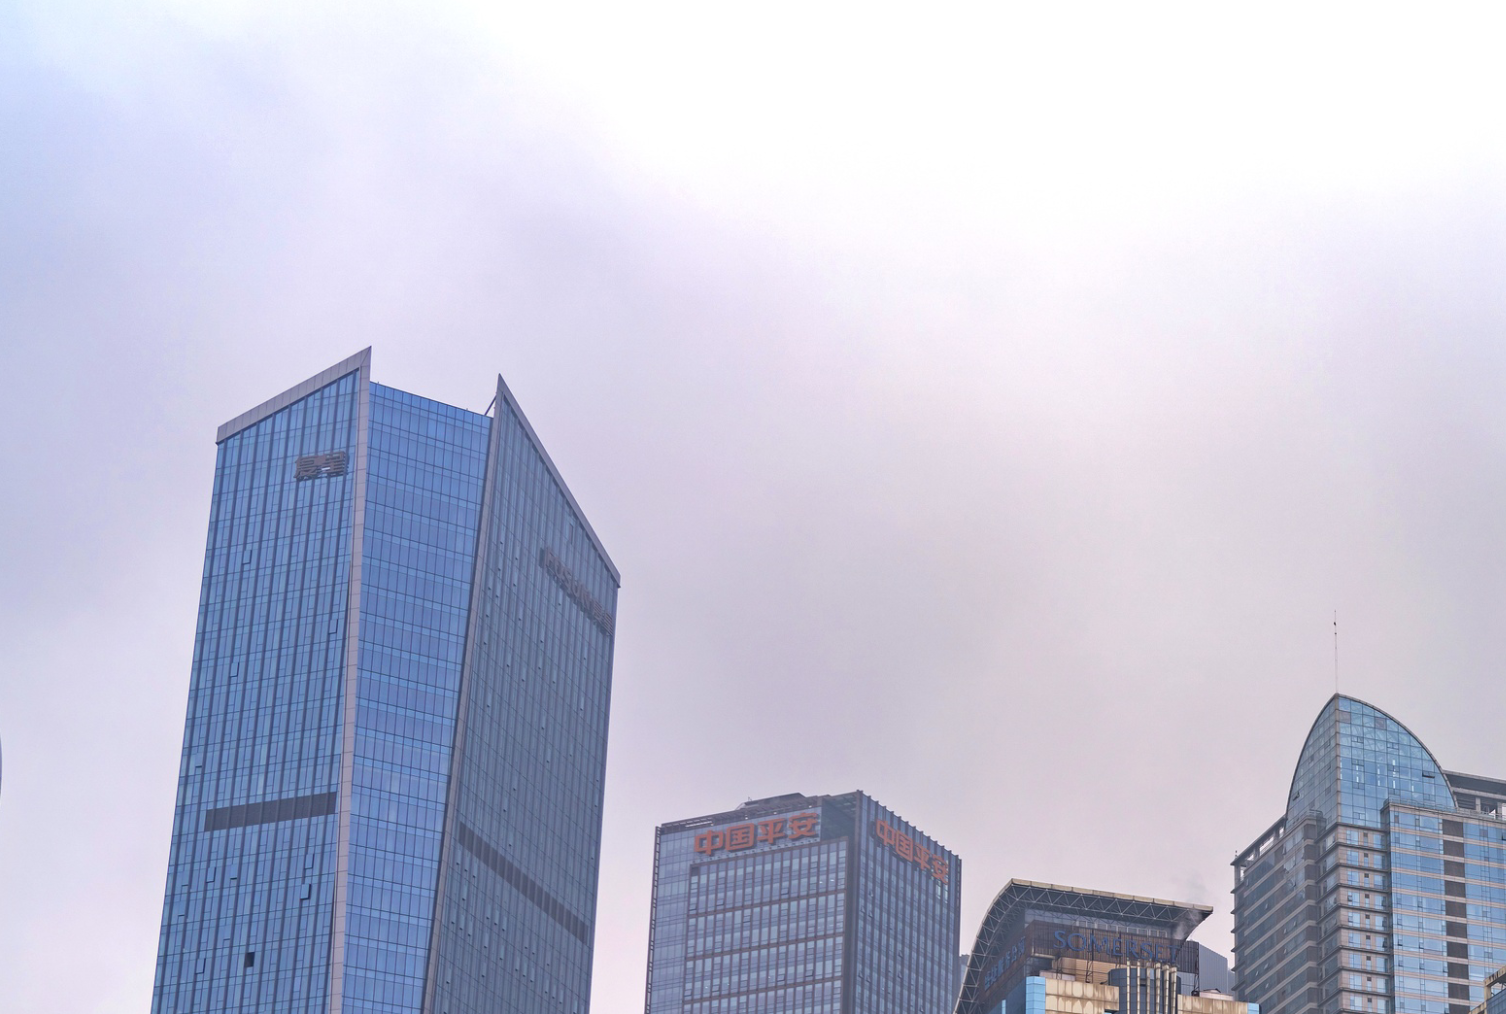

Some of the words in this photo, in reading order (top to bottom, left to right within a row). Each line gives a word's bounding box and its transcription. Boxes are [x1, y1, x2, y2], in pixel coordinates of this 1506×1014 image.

[693, 812, 819, 856] 中国平安
[875, 819, 949, 885] 中国平安
[1053, 930, 1180, 963] SOMERSET
